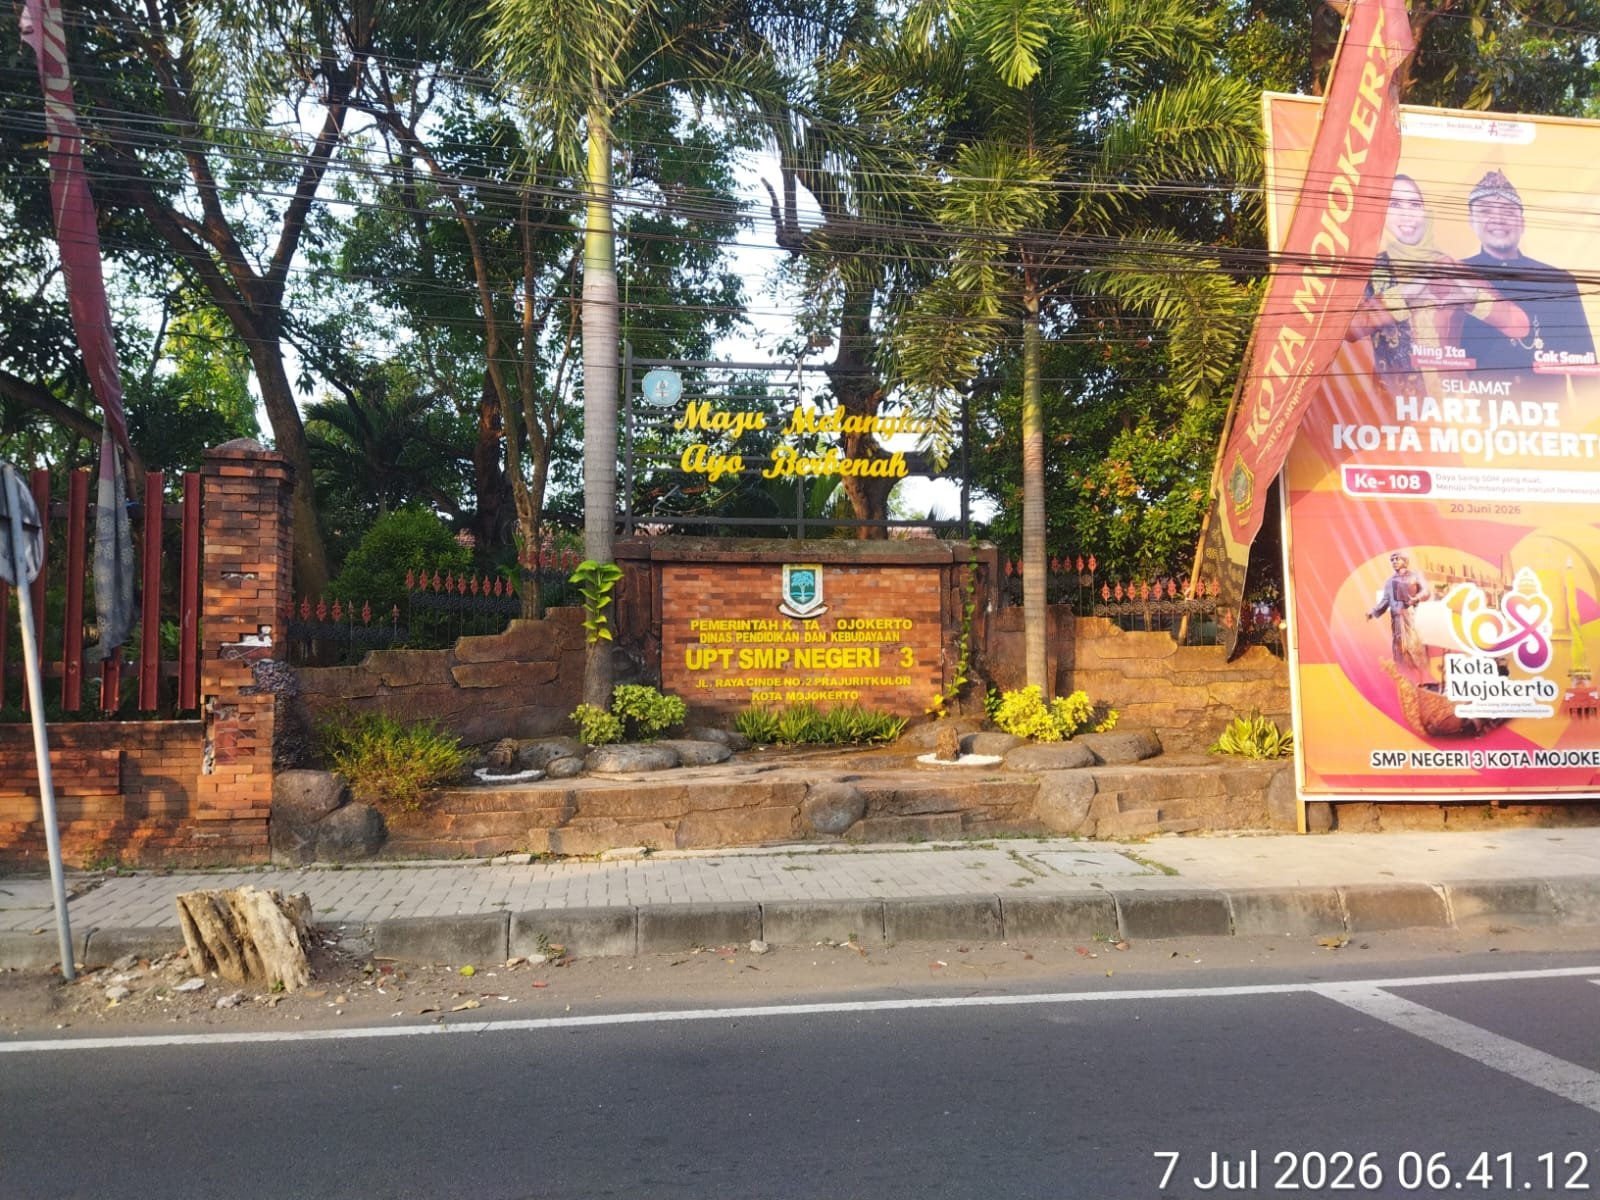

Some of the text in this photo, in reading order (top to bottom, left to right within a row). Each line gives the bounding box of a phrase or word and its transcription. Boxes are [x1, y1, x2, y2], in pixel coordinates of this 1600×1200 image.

[1246, 6, 1387, 446] KOTA MOJOKERT
[1412, 344, 1466, 360] Ning Ita
[1534, 351, 1594, 364] Cak Sandi
[1442, 379, 1512, 396] SELAMAT
[674, 400, 767, 439] Maju
[1396, 396, 1561, 431] HARI JADI
[1333, 424, 1600, 461] KOTA MOJOKERT
[680, 443, 909, 482] Ayo Berbenah
[1354, 473, 1422, 490] Ke- 108
[1435, 473, 1456, 482] Daya
[1450, 503, 1521, 515] 20 Juni 2026
[691, 619, 779, 631] PEMERINTAH
[700, 631, 900, 644] DINAS PENDIDIKAN DAN KEBUDAYAAN
[685, 647, 914, 671] UPT SMP NEGERI 3
[1449, 657, 1493, 676] Kota
[715, 678, 744, 688] RAYA
[746, 677, 781, 688] CINDE
[1451, 680, 1555, 701] Mojokerto
[751, 690, 859, 701] KOTA MOJOKERTO
[1372, 752, 1407, 767] SMP
[1411, 752, 1469, 767] NEGERI
[1473, 752, 1483, 767] 3
[1487, 752, 1531, 767] KOTA
